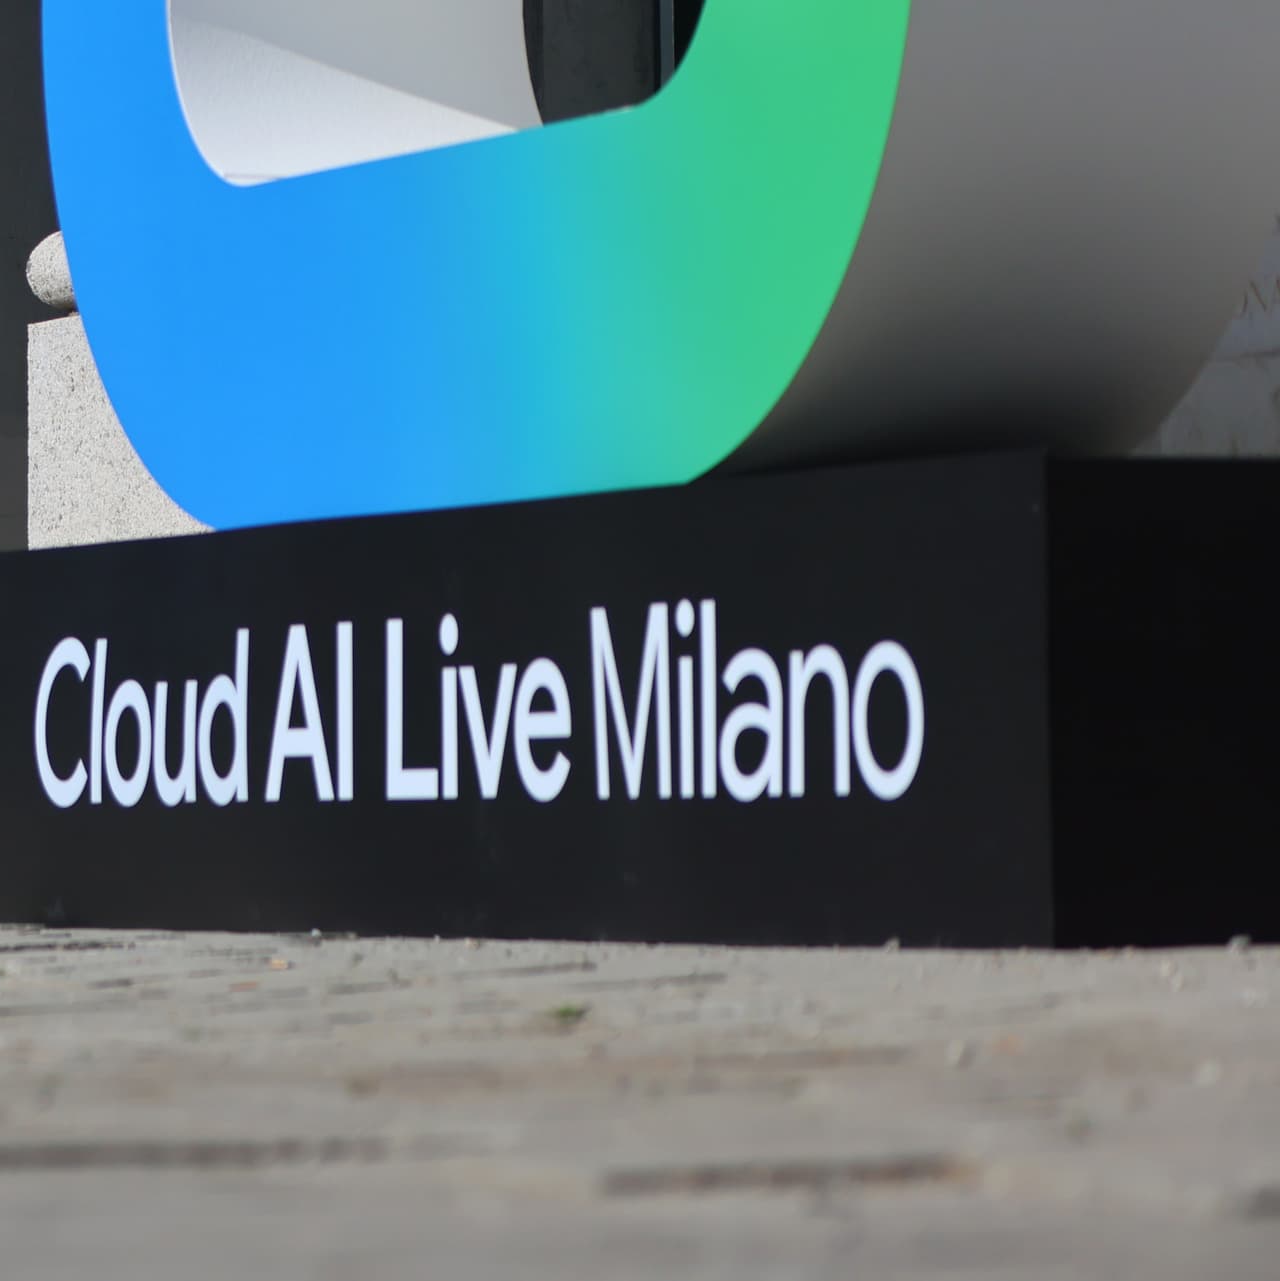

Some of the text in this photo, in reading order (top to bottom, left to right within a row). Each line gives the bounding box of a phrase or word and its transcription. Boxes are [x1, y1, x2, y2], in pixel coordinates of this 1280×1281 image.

[35, 599, 925, 808] Cloud AI Live Milano
